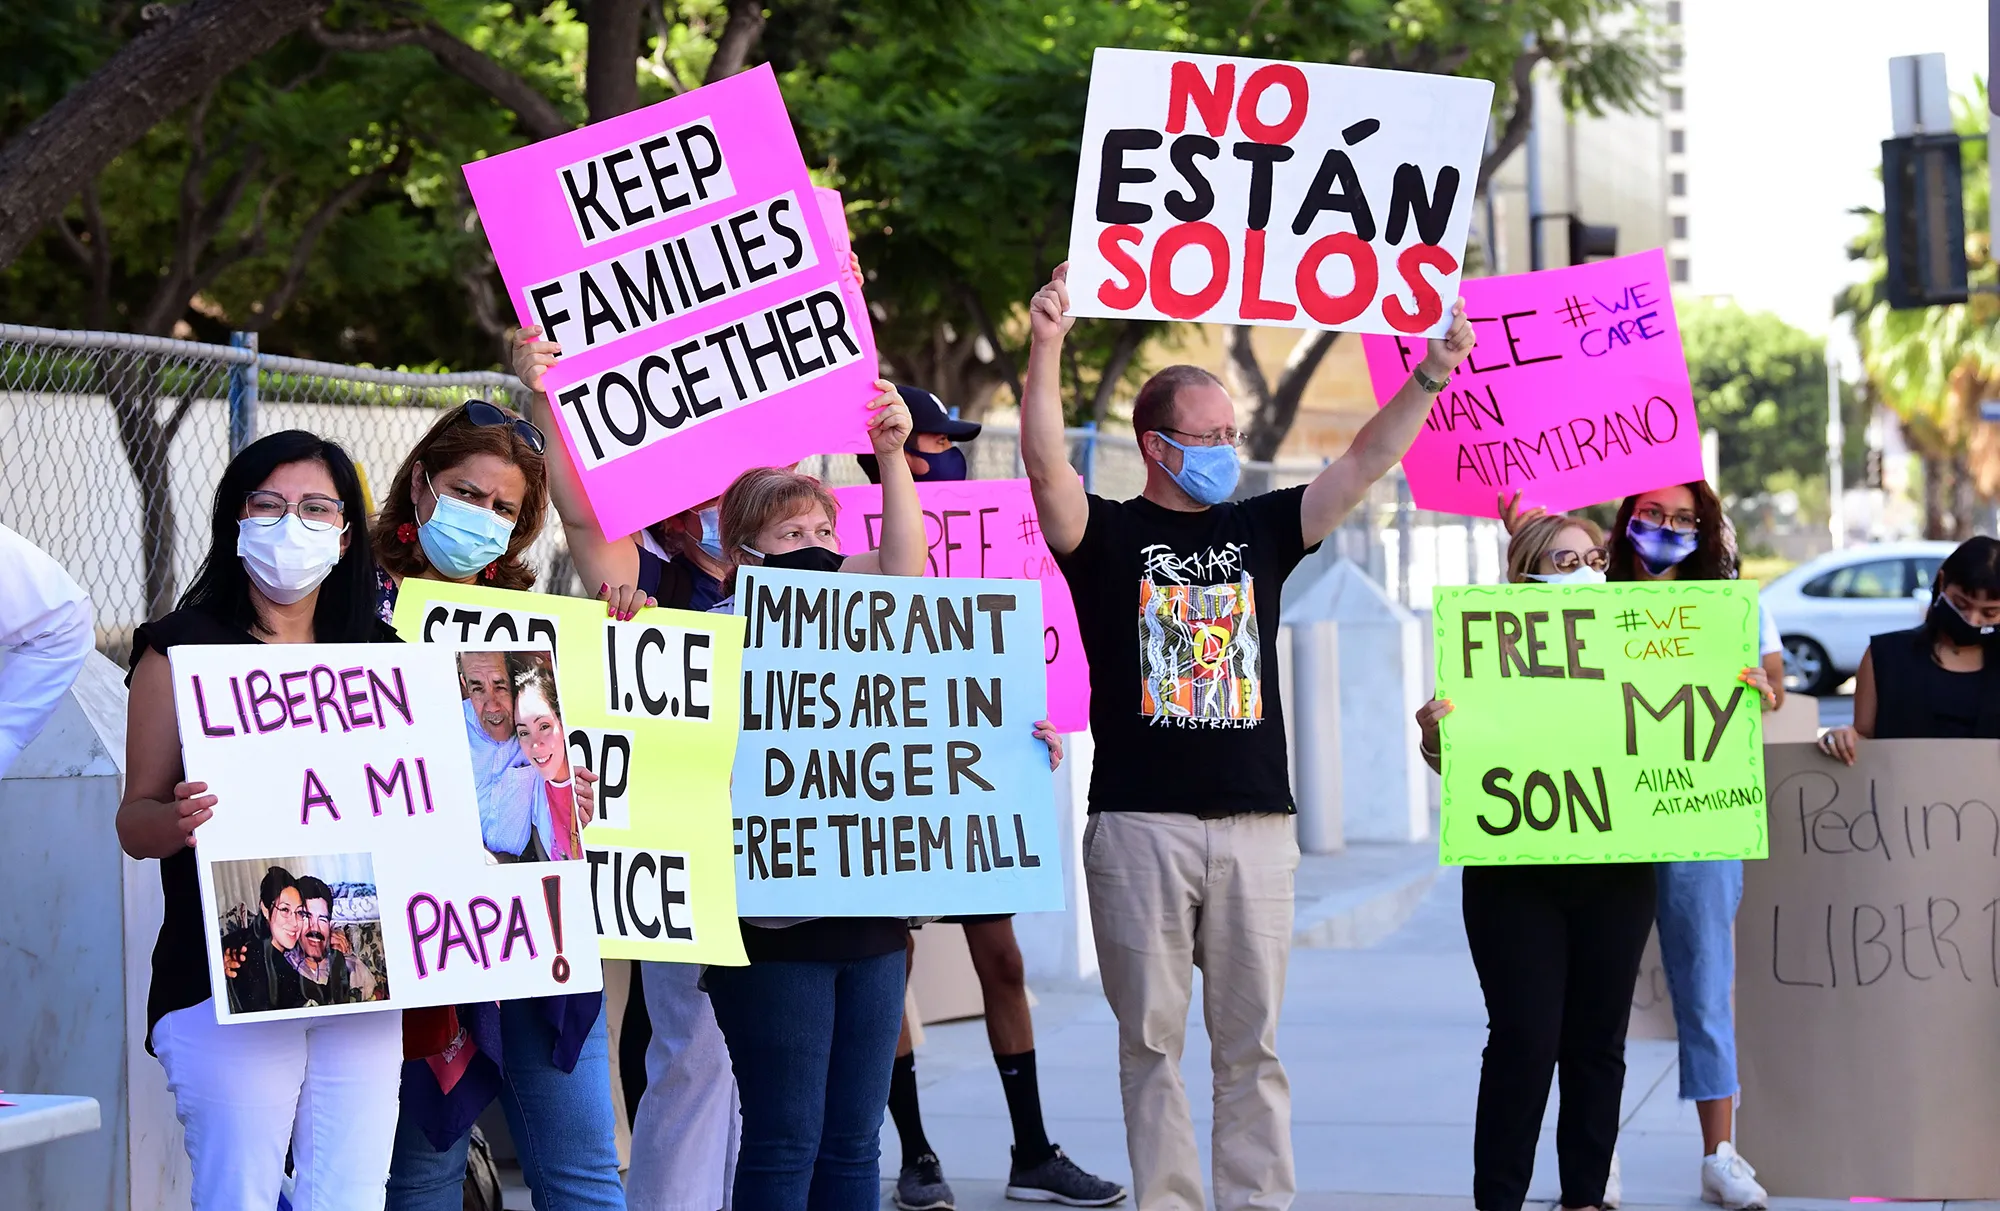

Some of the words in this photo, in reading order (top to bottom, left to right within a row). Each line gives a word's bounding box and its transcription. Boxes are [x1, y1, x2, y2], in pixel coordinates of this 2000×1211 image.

[1165, 61, 1309, 144] NO
[562, 124, 722, 241] KEEP
[1096, 118, 1460, 246] ESTÁN
[531, 199, 802, 356] FAMILIES
[1098, 221, 1459, 334] SOLOS
[1580, 311, 1665, 357] CARE
[559, 290, 860, 460] TOGETHER
[743, 575, 1017, 654] IMMIGRANT
[1461, 608, 1605, 681] FREE
[1624, 637, 1694, 660] CARE
[190, 664, 415, 738] LIBEREN
[607, 625, 711, 720] I.C.E
[743, 670, 841, 732] LIVES
[849, 673, 928, 729] ARE
[947, 676, 1003, 728] IN
[1160, 717, 1257, 730] AUSTRALIA
[1621, 682, 1745, 762] MY
[301, 767, 341, 825] A
[364, 757, 434, 816] MI
[765, 741, 996, 801] DANGER
[1476, 766, 1613, 837] SON
[827, 813, 953, 878] THEM
[966, 813, 1041, 873] ALL
